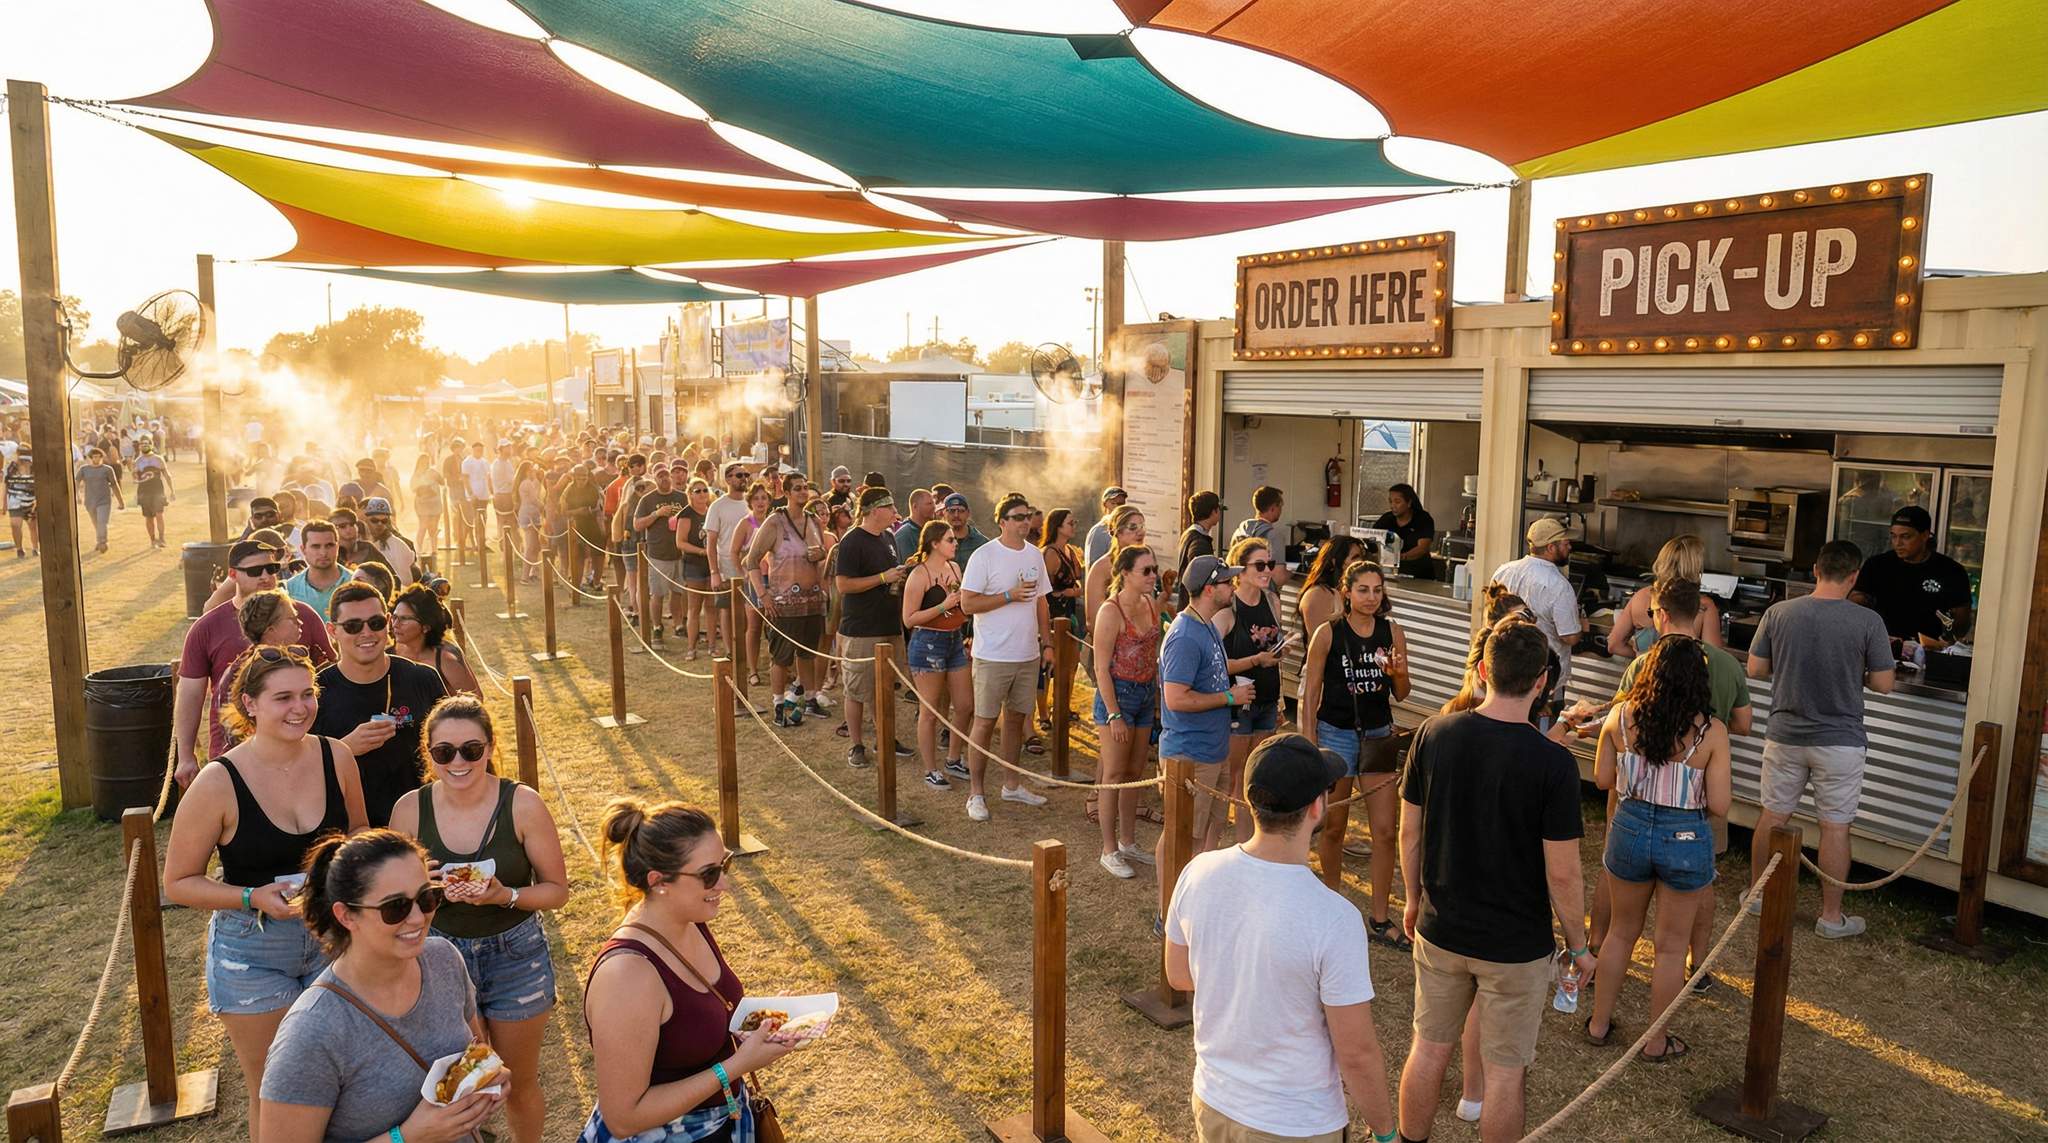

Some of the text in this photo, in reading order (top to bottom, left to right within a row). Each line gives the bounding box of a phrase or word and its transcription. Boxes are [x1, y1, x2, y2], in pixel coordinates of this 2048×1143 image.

[1254, 269, 1427, 331] ORDER HERE
[1599, 227, 1858, 317] PICK-UP
